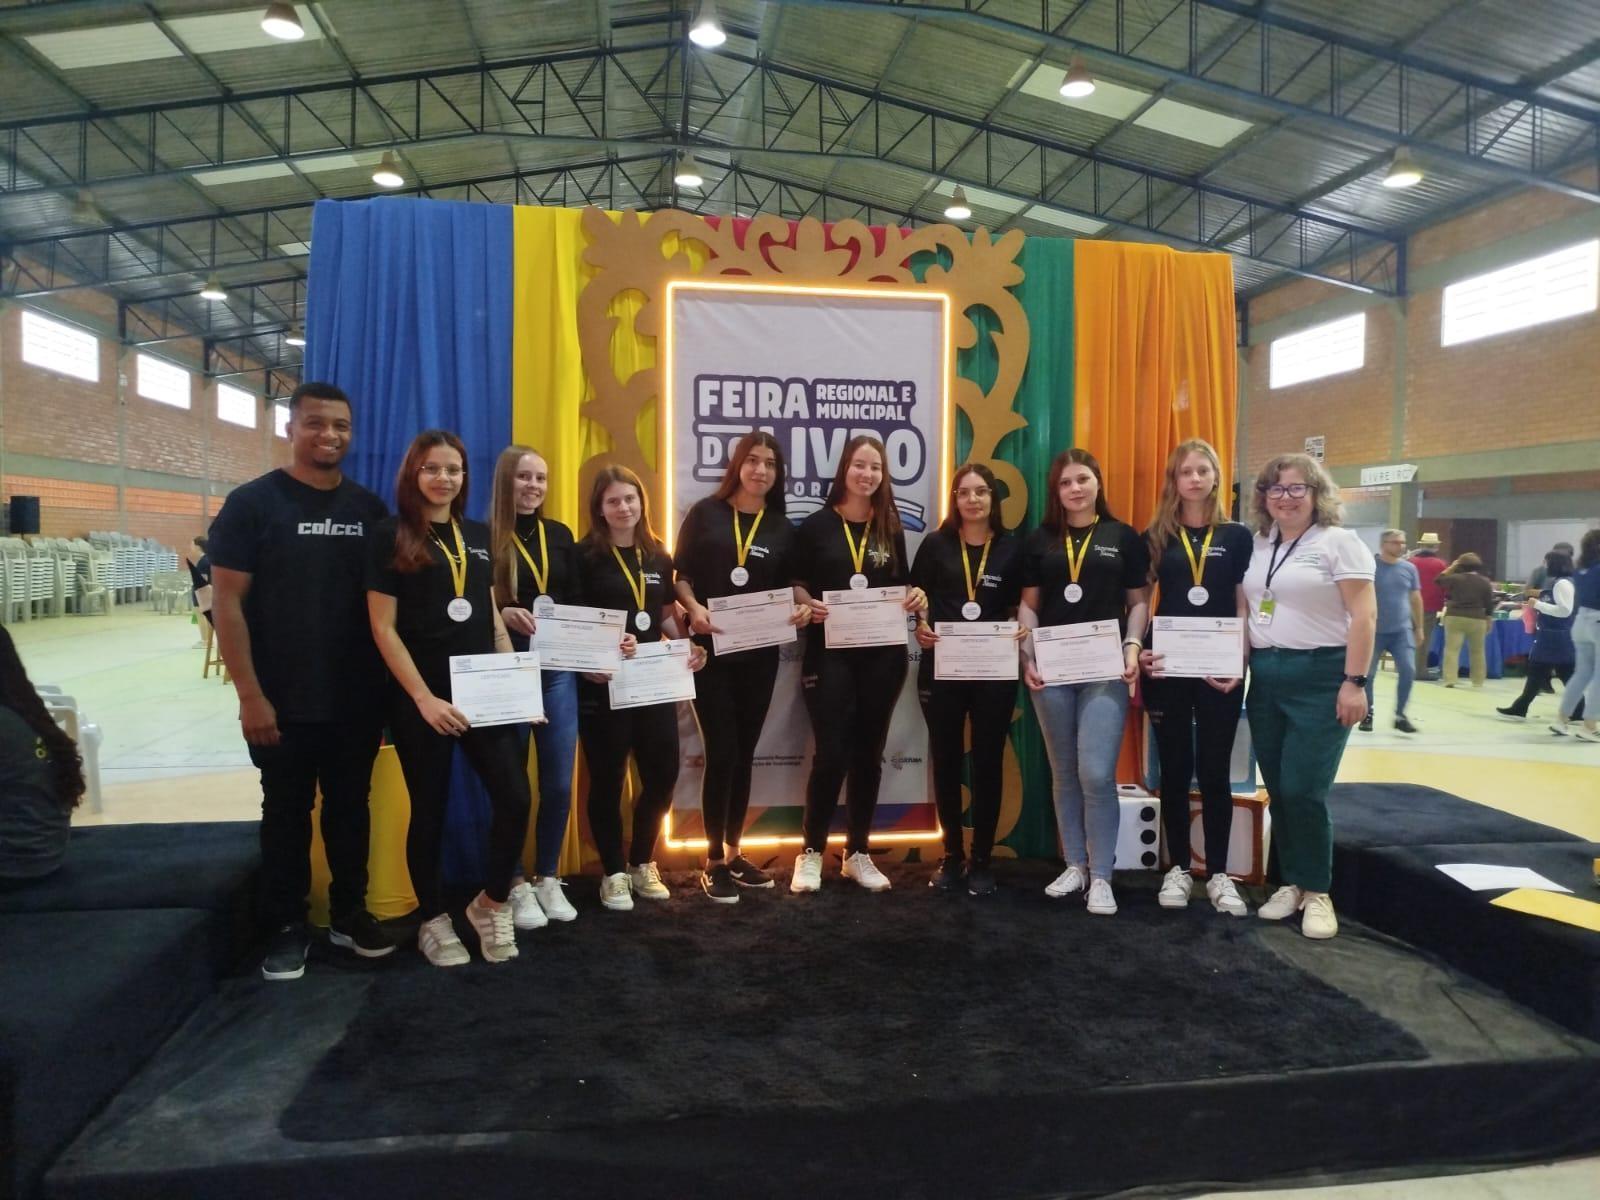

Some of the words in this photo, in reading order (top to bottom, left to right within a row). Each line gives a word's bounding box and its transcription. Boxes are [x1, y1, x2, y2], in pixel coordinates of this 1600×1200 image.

[699, 380, 810, 419] FEIRA
[816, 384, 898, 402] REGIONAL
[902, 386, 911, 402] E
[816, 403, 906, 421] MUNICIPAL
[298, 518, 363, 537] colcci
